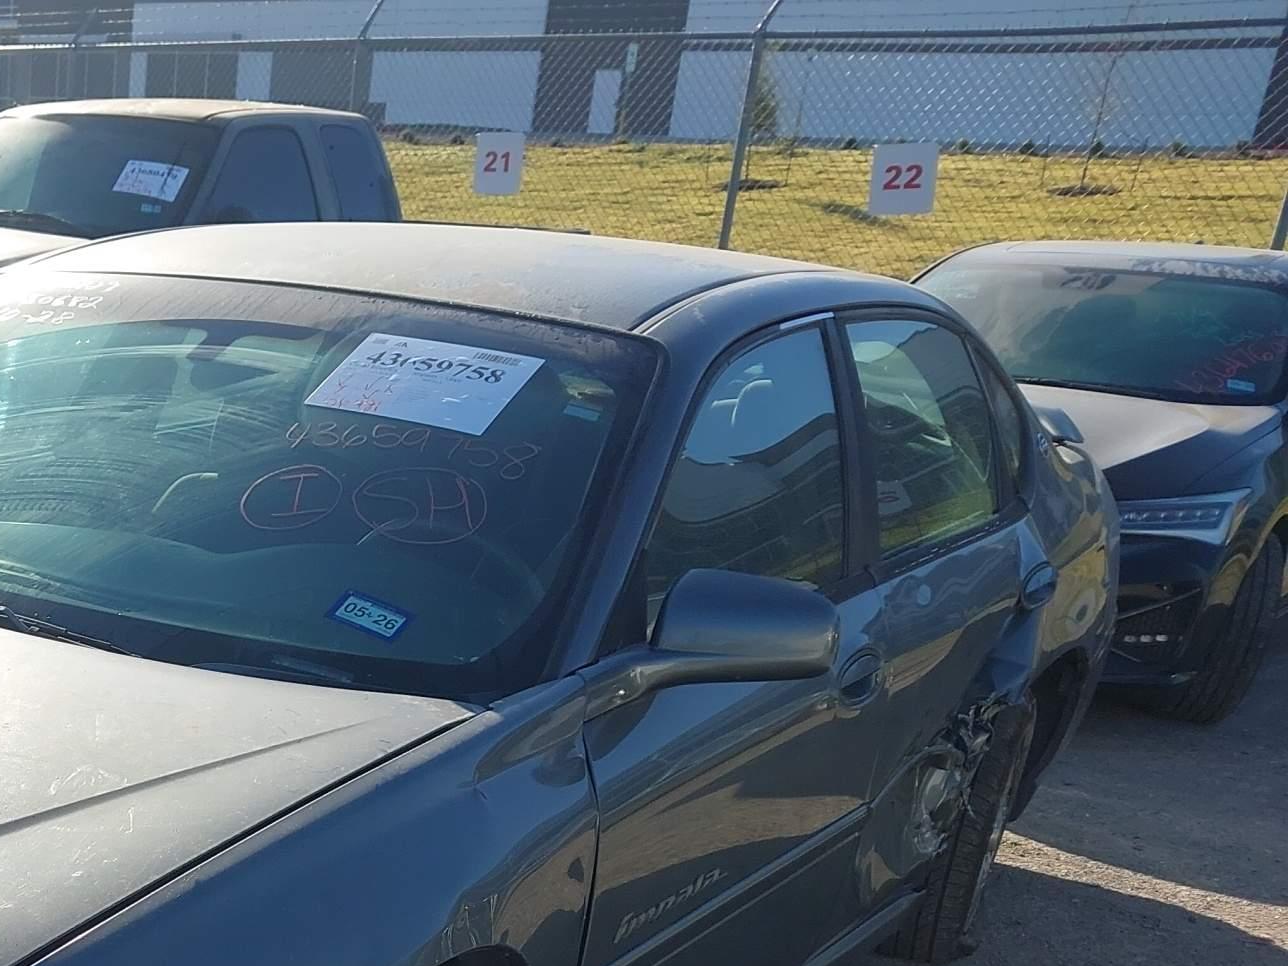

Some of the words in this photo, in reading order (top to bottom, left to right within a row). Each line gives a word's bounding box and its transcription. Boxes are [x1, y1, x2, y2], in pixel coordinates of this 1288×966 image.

[483, 151, 511, 172] 21
[882, 164, 923, 190] 22
[284, 421, 543, 480] 43659758
